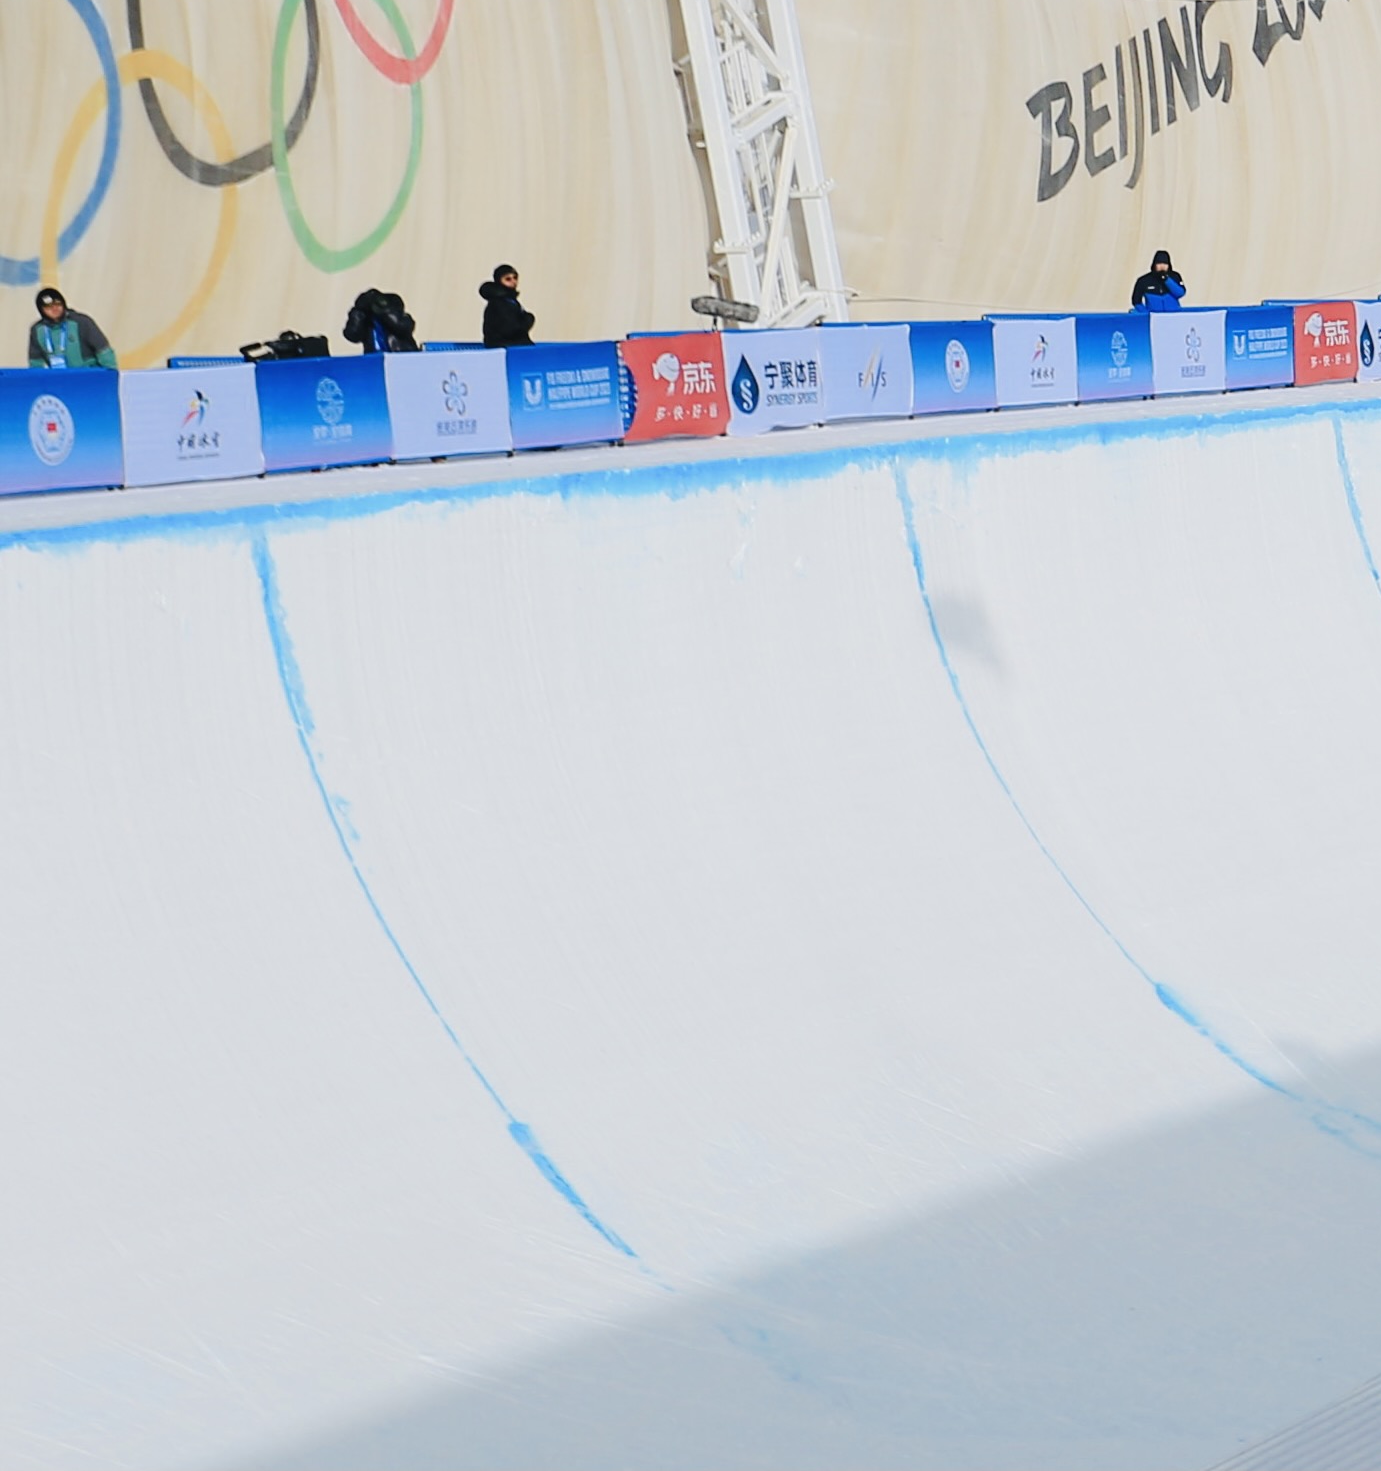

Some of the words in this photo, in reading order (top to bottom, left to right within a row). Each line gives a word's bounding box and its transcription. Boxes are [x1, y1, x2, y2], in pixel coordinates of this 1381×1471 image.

[1323, 320, 1350, 347] 京东
[681, 361, 717, 395] 京东
[764, 359, 817, 390] 宁聚体育
[766, 393, 796, 407] SYNERGY
[797, 391, 818, 405] SPORTS
